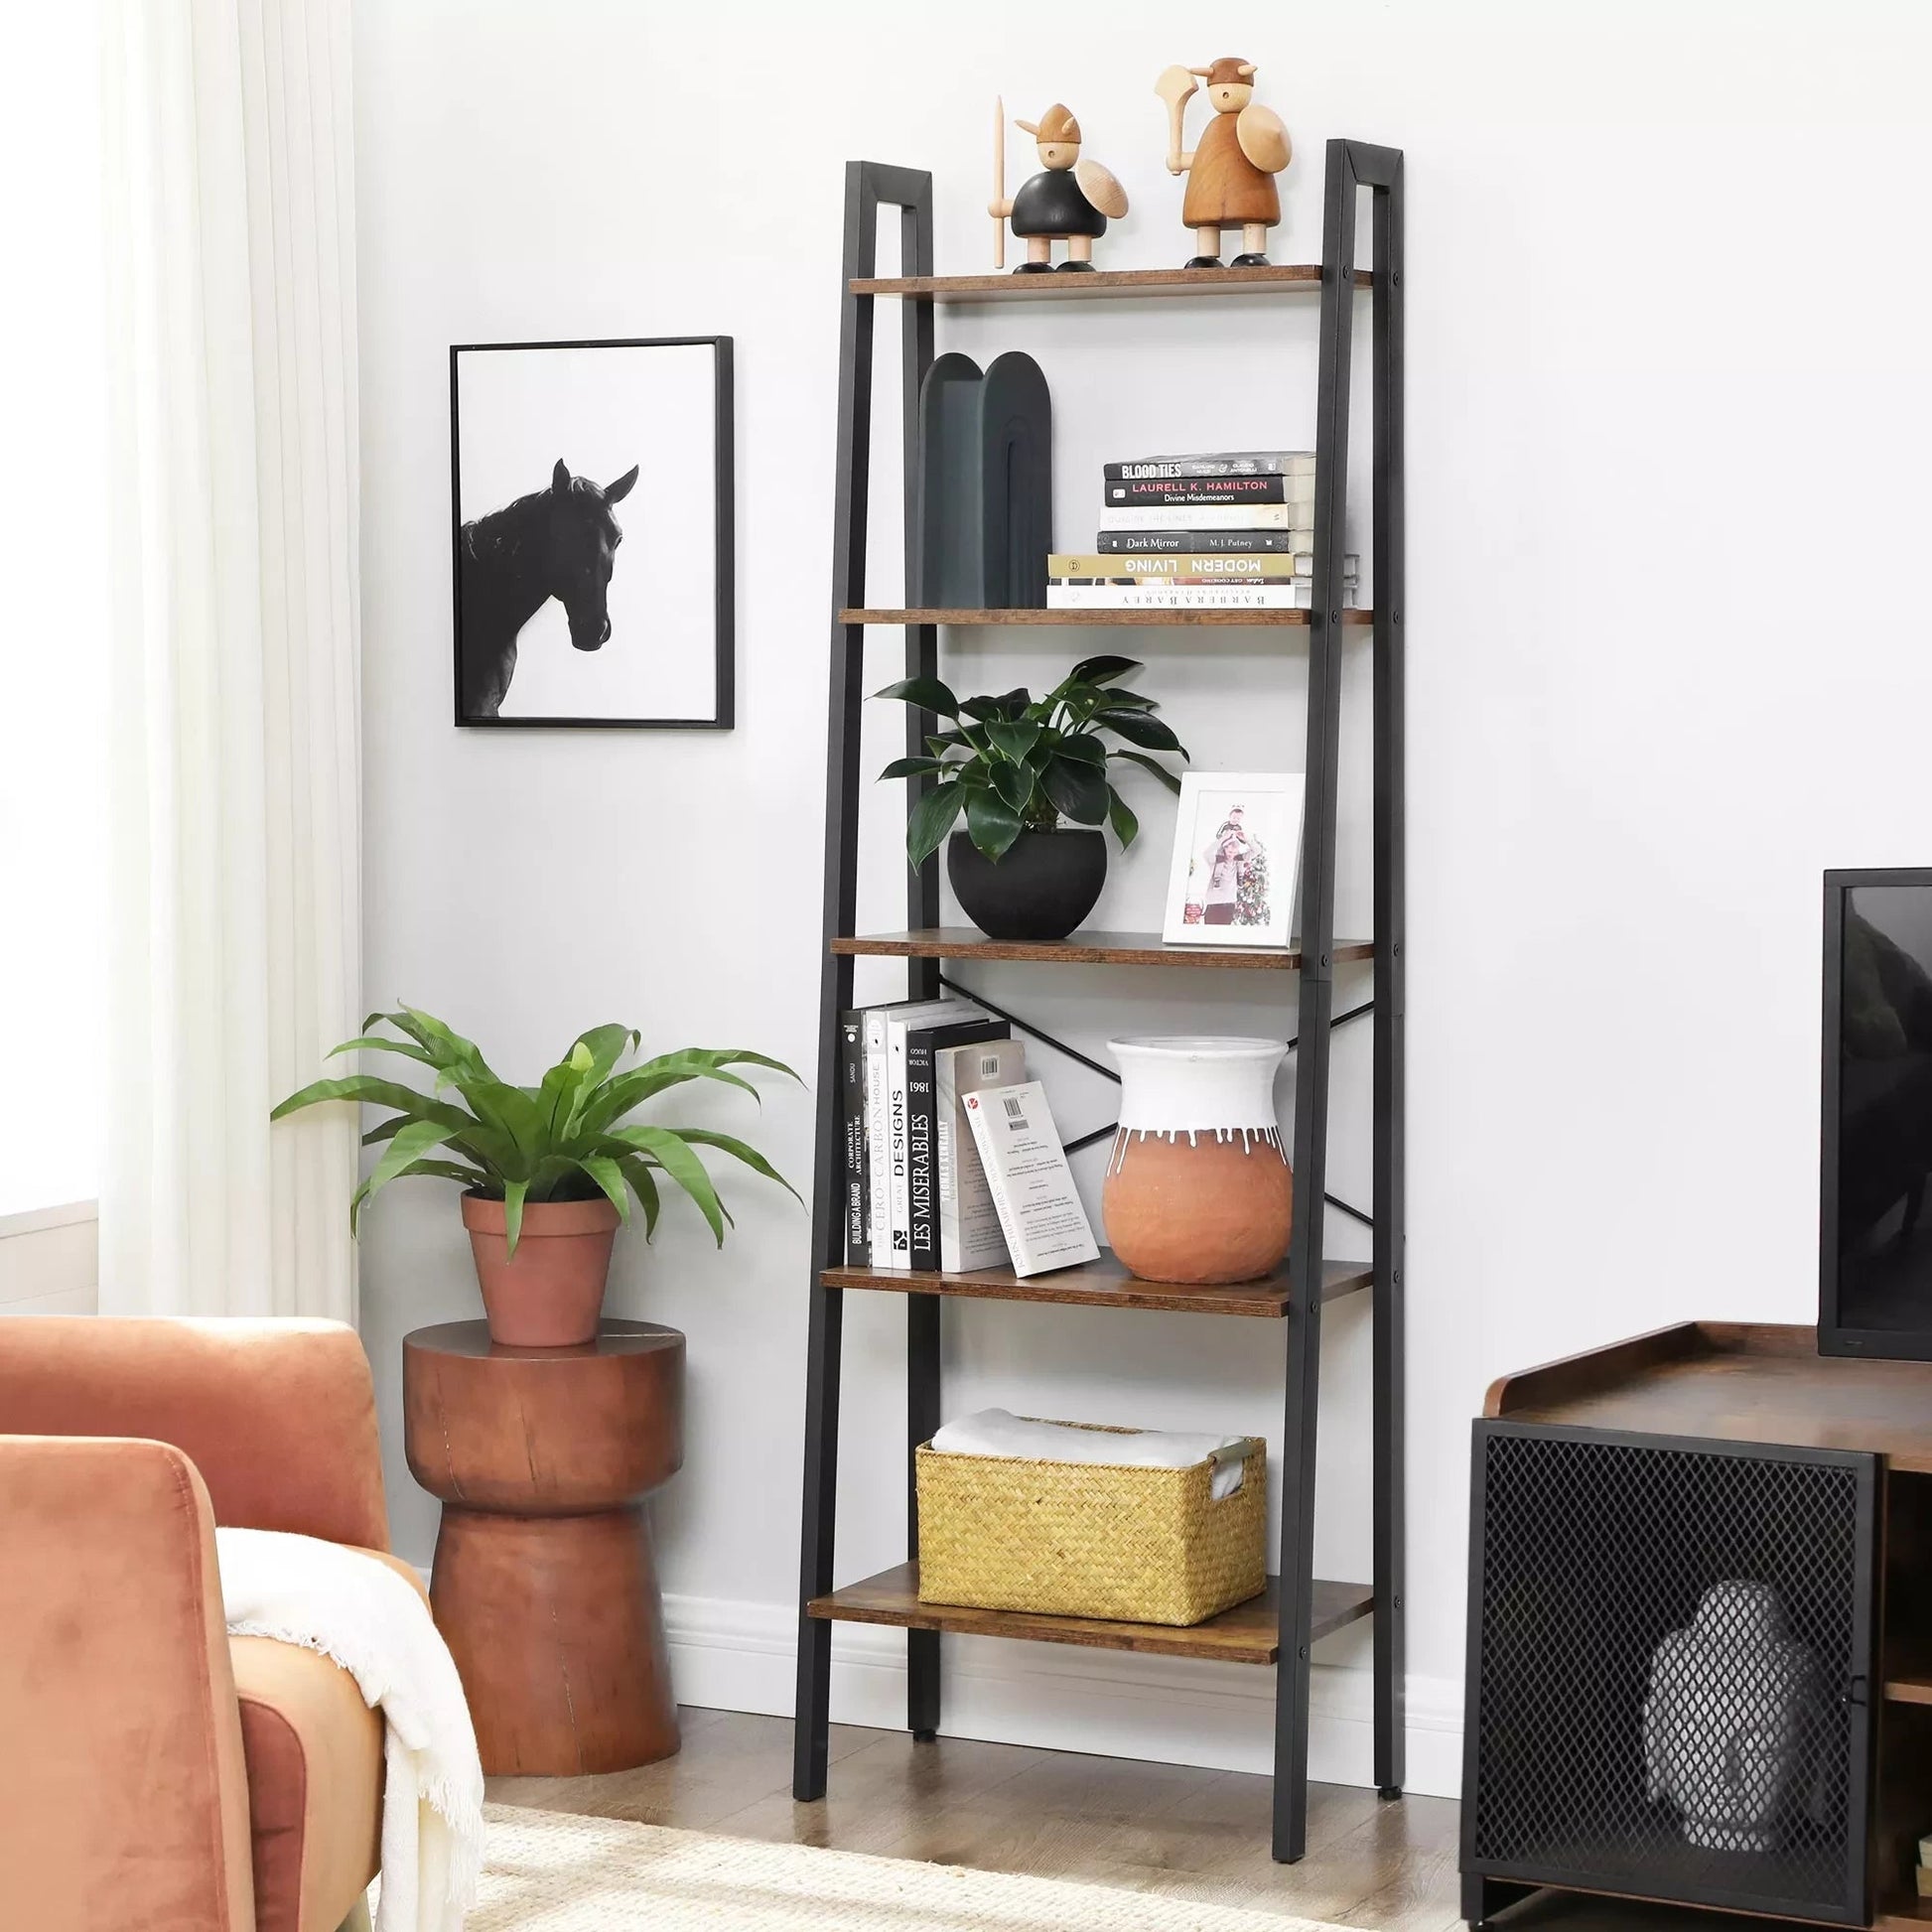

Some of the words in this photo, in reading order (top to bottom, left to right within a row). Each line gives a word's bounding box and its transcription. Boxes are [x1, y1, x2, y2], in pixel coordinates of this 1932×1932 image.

[1122, 464, 1156, 480] BLOOD
[1159, 463, 1182, 479] TIES
[1132, 483, 1186, 492] LAURELL
[1190, 483, 1202, 491] K.
[1206, 481, 1268, 491] HAMILTON
[1164, 493, 1185, 502] Divine
[1186, 493, 1234, 502] Misdemeanors
[1126, 537, 1150, 549] Dark
[1150, 537, 1179, 550] Mirror
[1227, 538, 1253, 548] Putney
[1125, 560, 1177, 572] LIVING
[1191, 559, 1261, 572] MODERN
[893, 1090, 904, 1176] DESIGNS
[911, 1114, 930, 1218] MISERABLES
[850, 1182, 861, 1206] BRAND
[851, 1212, 862, 1244] BUILDING
[913, 1223, 931, 1252] LES
